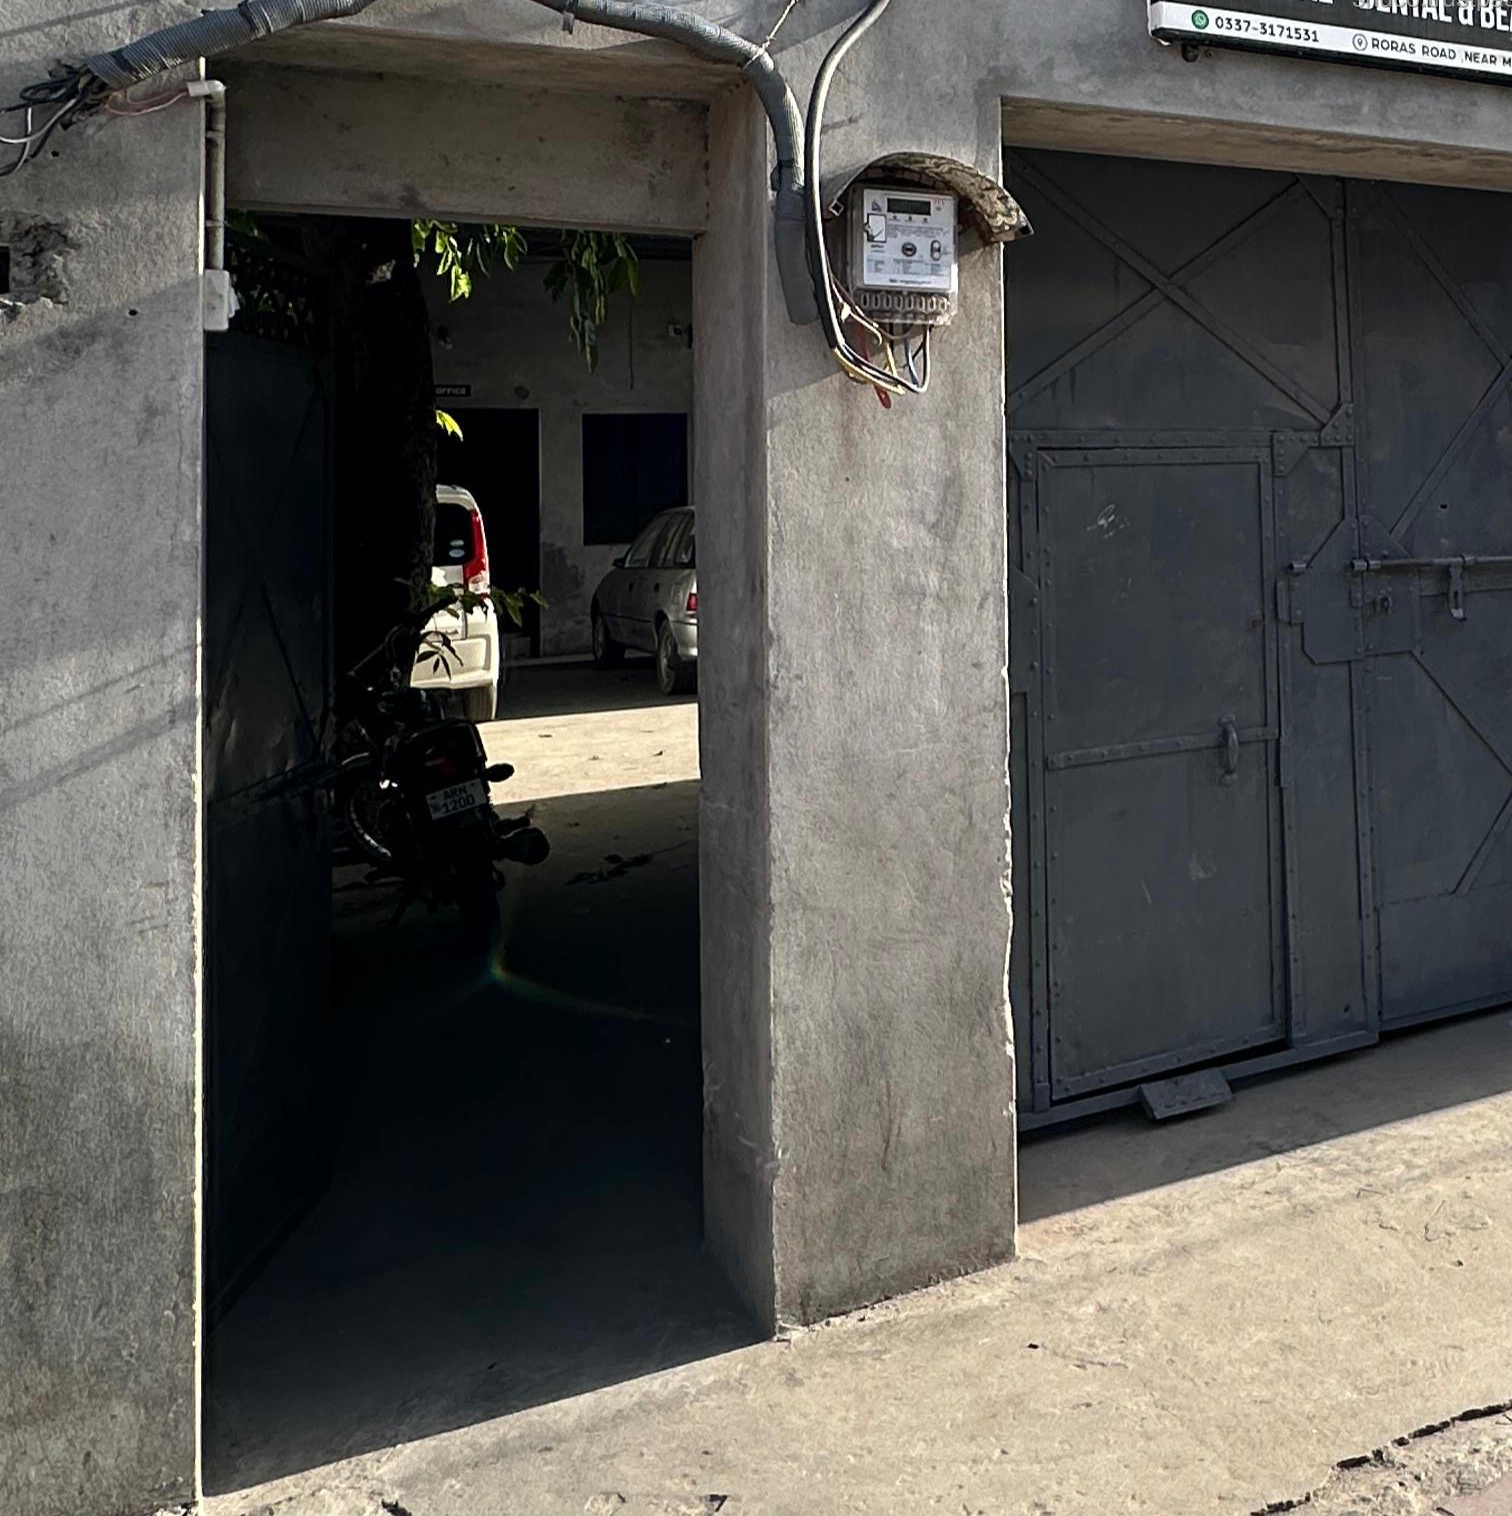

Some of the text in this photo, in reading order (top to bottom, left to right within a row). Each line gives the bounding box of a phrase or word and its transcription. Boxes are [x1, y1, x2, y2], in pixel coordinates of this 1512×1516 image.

[1214, 16, 1320, 43] 0337-3171531
[1371, 37, 1416, 55] RORAS
[1421, 46, 1457, 61] ROAD
